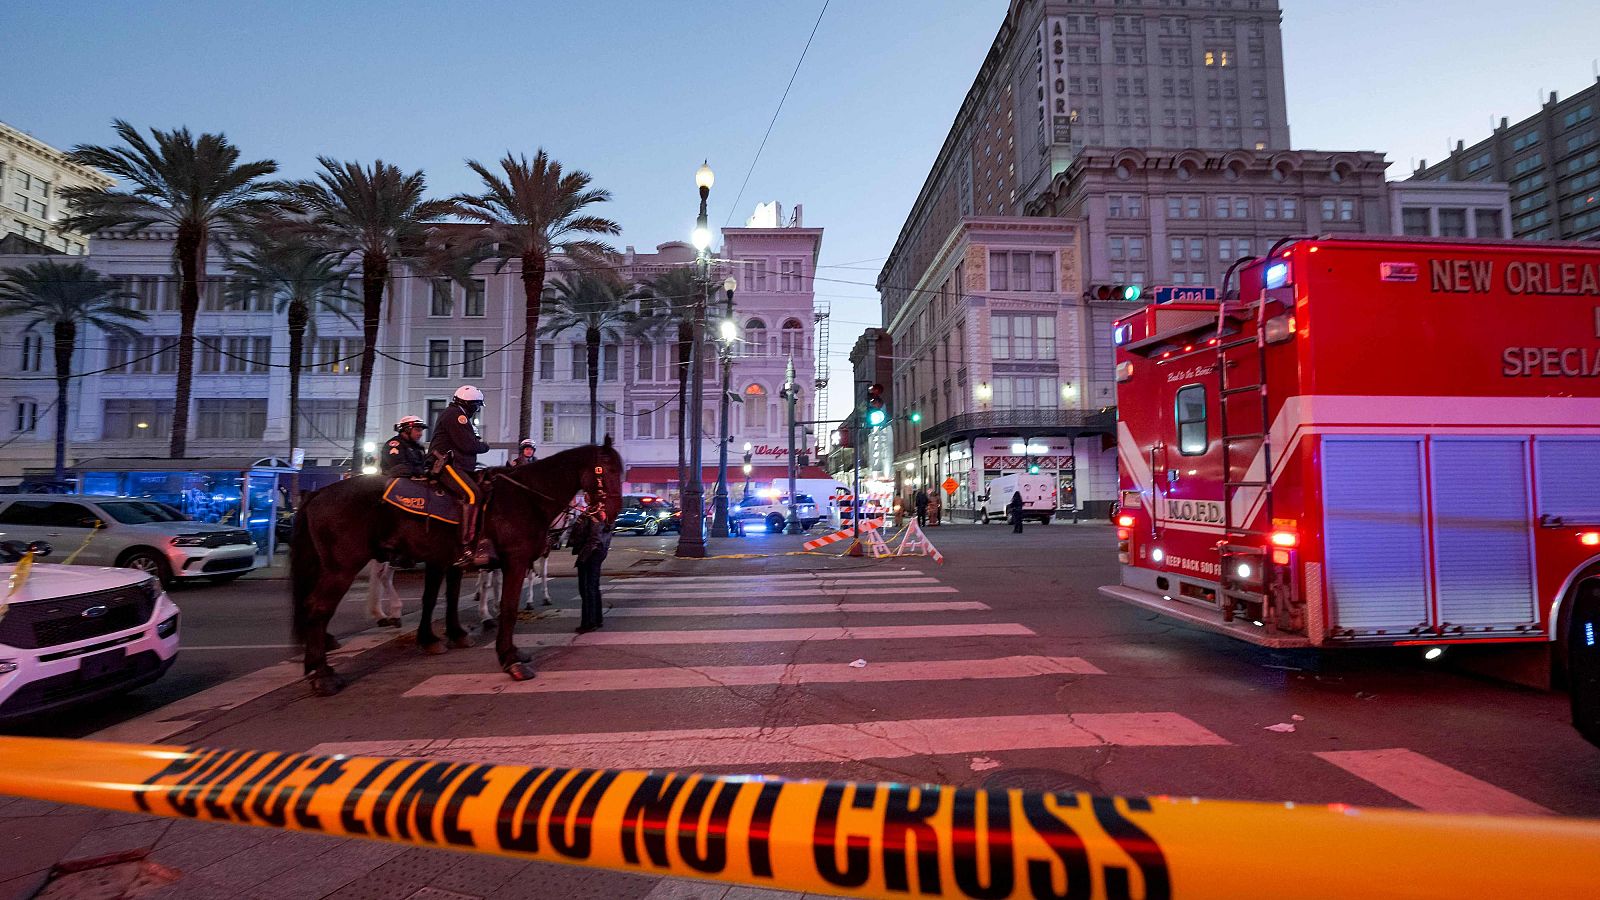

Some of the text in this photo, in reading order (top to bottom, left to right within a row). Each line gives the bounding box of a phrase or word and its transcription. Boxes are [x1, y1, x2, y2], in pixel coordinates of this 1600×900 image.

[1053, 21, 1065, 113] ASTOR
[1431, 259, 1600, 294] NEW ORLEA
[1171, 287, 1206, 302] Canal
[754, 445, 812, 459] Walgrens
[1168, 500, 1224, 523] N.O.F.D.
[1166, 555, 1180, 567] KEEP
[1182, 558, 1199, 571] BACK
[1201, 561, 1213, 574] 500
[133, 747, 1172, 900] POLICE LINE DO NOT CROSS
